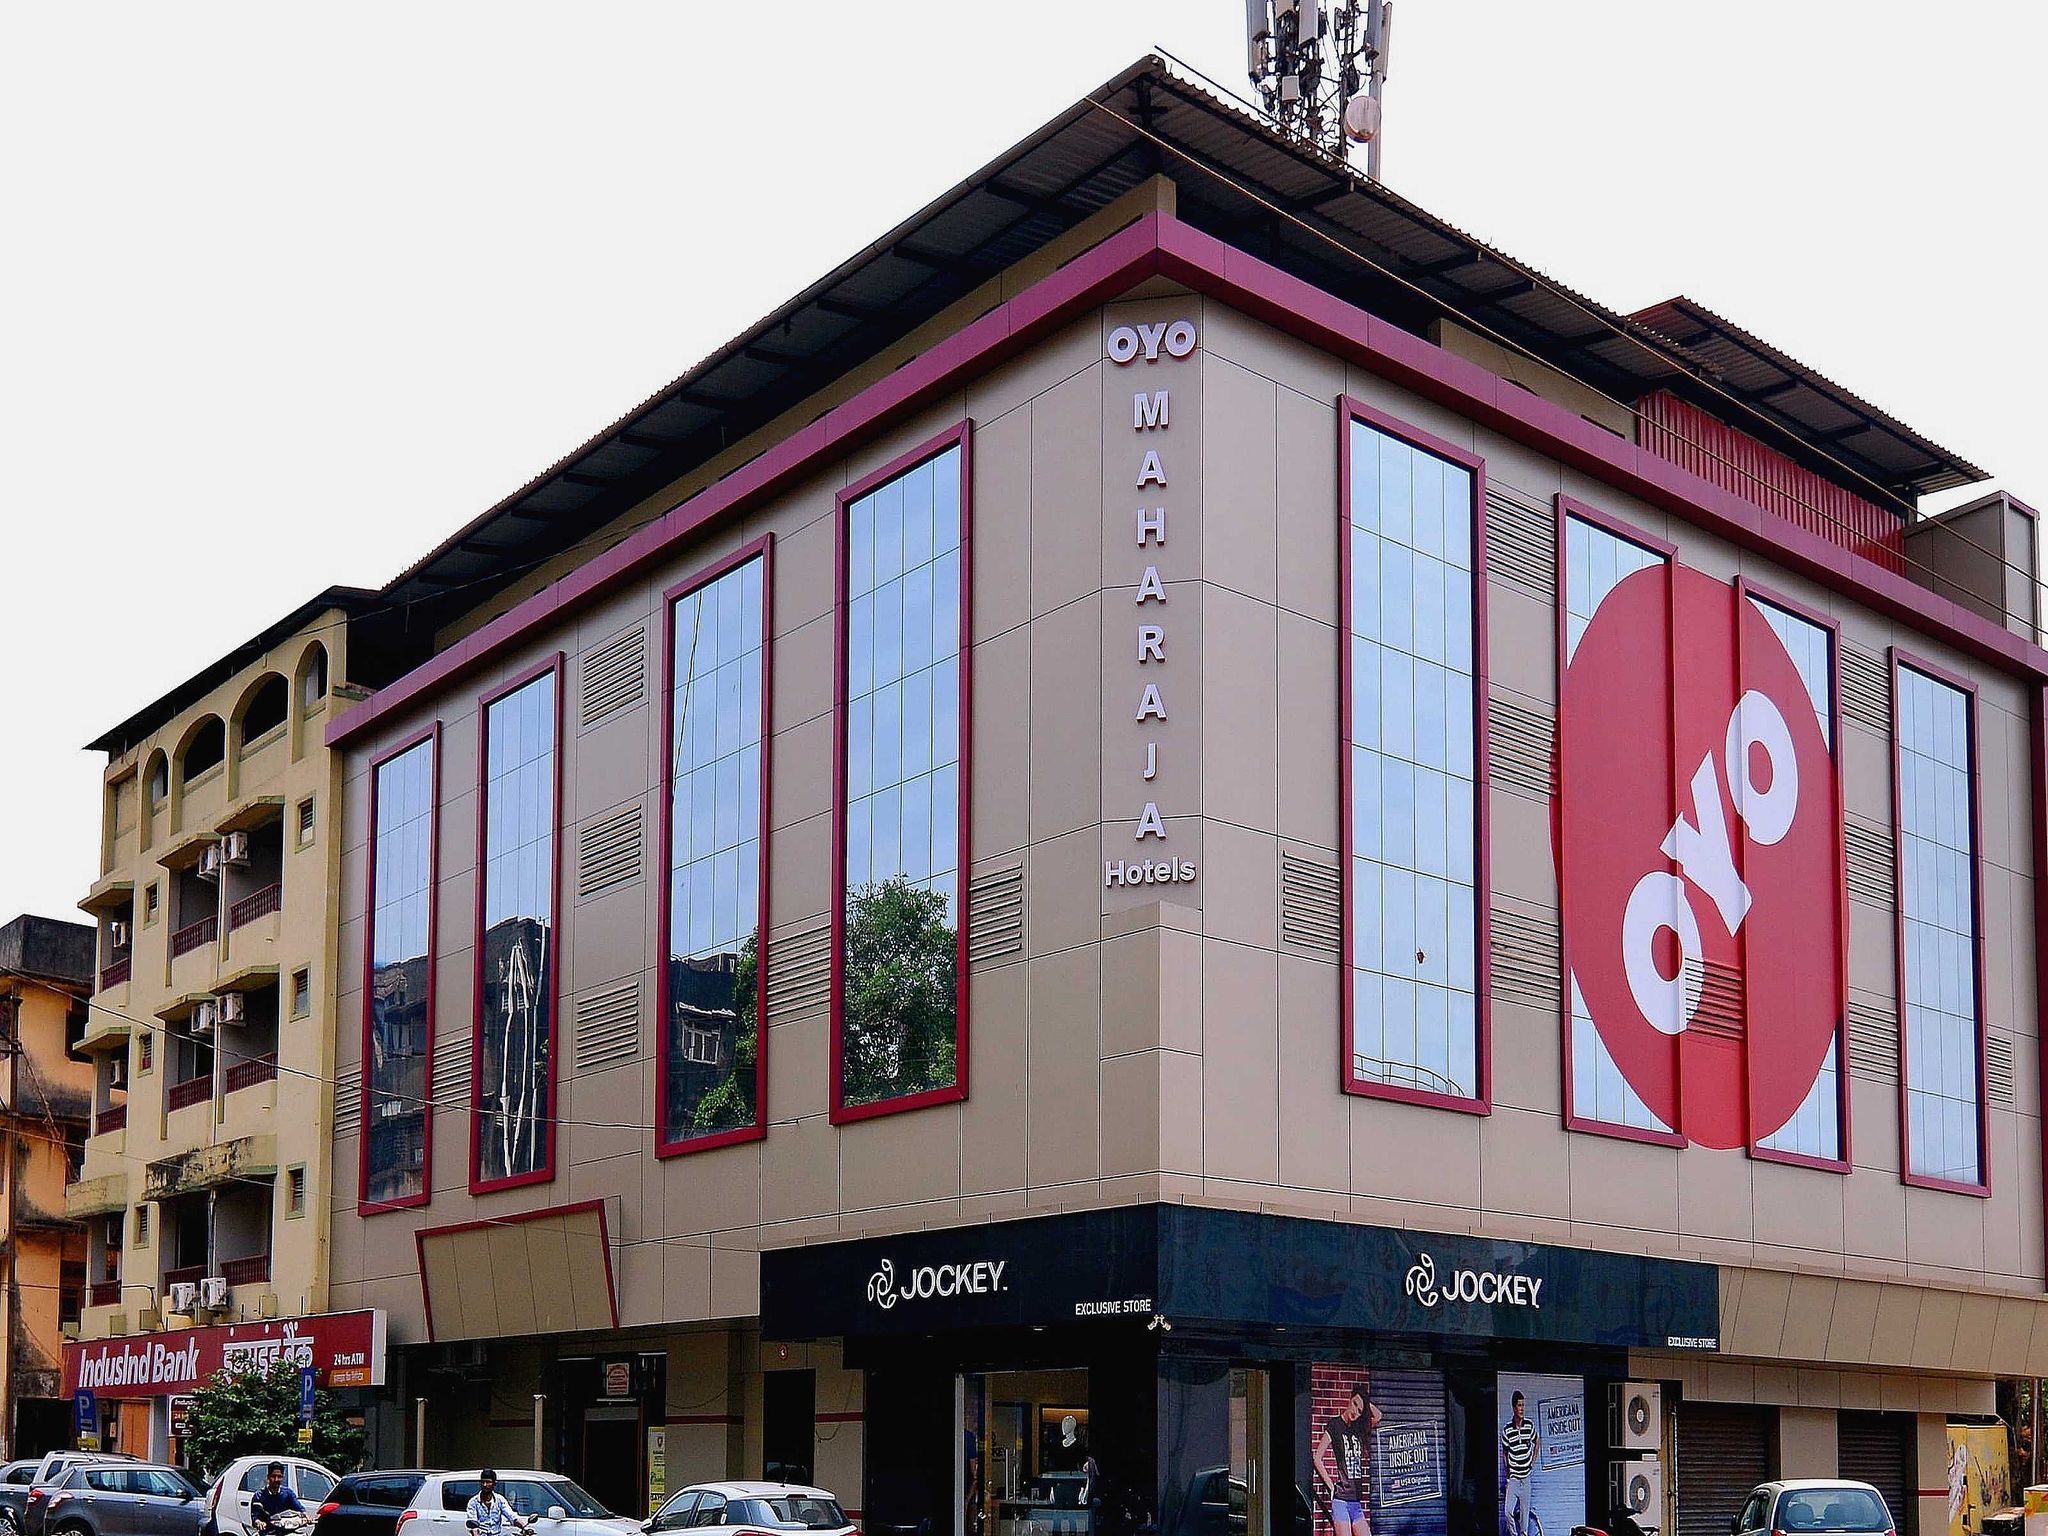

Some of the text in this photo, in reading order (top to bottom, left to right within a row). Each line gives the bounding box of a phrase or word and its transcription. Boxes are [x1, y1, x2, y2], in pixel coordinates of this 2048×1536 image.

[1107, 320, 1197, 363] OYO
[1134, 389, 1169, 841] MAHARAJA
[1105, 856, 1196, 886] Hotels
[1075, 1299, 1152, 1315] EXCLUSIVE STORE
[1667, 1336, 1717, 1349] EXCLUSIVE STORE
[79, 1336, 200, 1388] IndusInd Bank
[351, 1352, 365, 1364] ATM
[79, 1395, 90, 1416] P
[1568, 1418, 1581, 1432] OUT
[1389, 1447, 1429, 1467] INSIDE OUT
